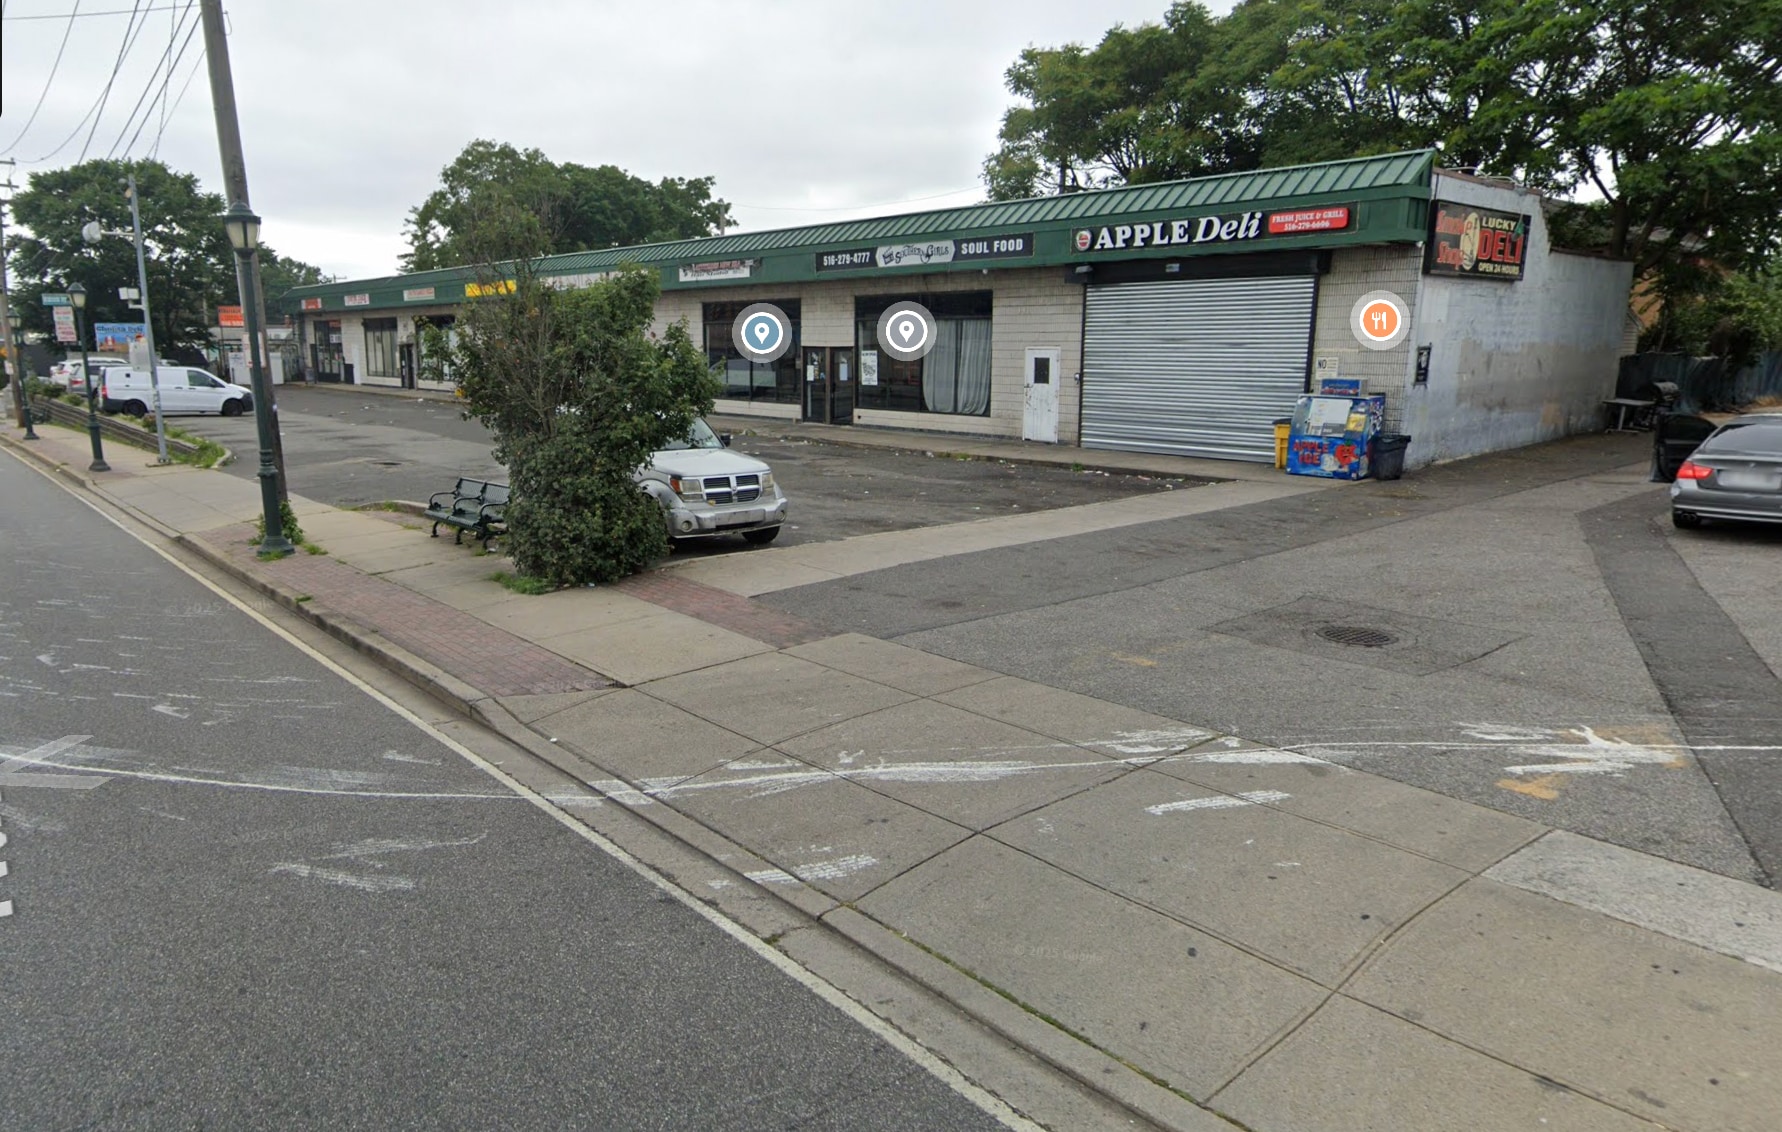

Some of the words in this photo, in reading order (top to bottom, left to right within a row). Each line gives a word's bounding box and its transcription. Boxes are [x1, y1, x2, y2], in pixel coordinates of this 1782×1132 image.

[1272, 214, 1294, 224] FRESH
[1295, 212, 1315, 222] JUICE
[1323, 210, 1344, 219] GRILL
[1482, 216, 1517, 231] LUCKY
[1094, 220, 1189, 249] APPLE
[1193, 211, 1263, 242] Deli
[961, 241, 990, 255] SOUL
[993, 238, 1024, 252] FOOD
[1477, 229, 1525, 263] DELI
[823, 252, 871, 266] 516-279-4777
[1478, 262, 1494, 272] OPEN
[1317, 359, 1327, 369] NO
[1293, 440, 1330, 454] APPLE
[1298, 452, 1321, 465] ICE
